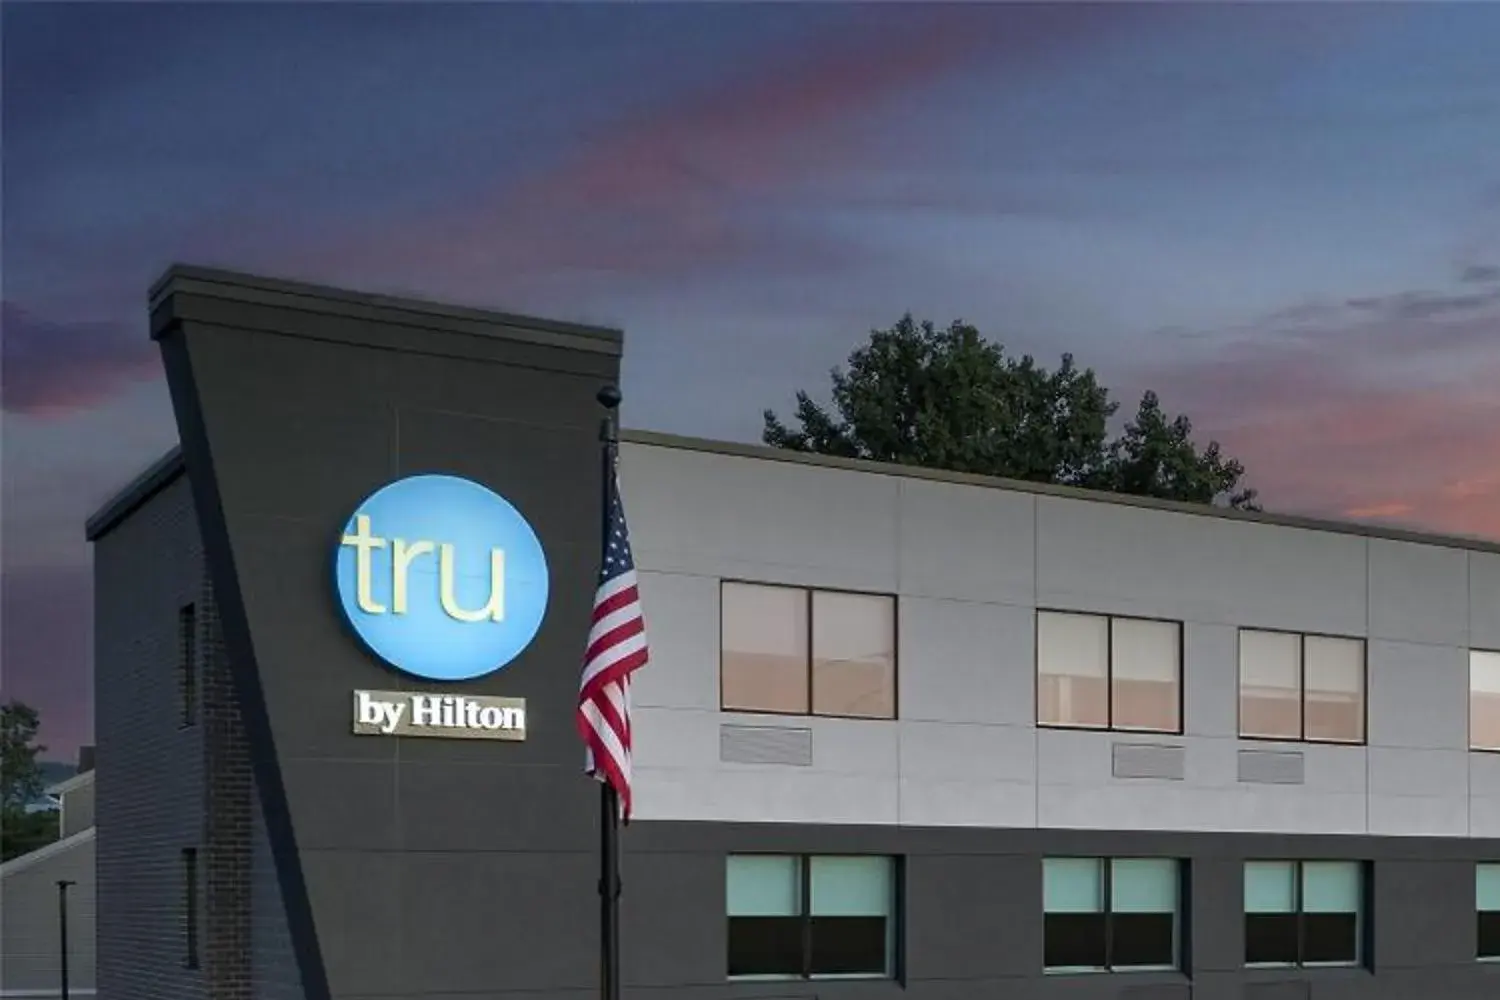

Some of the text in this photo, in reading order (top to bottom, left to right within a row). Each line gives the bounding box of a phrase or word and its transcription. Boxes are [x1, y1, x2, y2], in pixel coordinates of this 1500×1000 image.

[341, 514, 505, 623] tru
[359, 692, 524, 733] by Hilton
